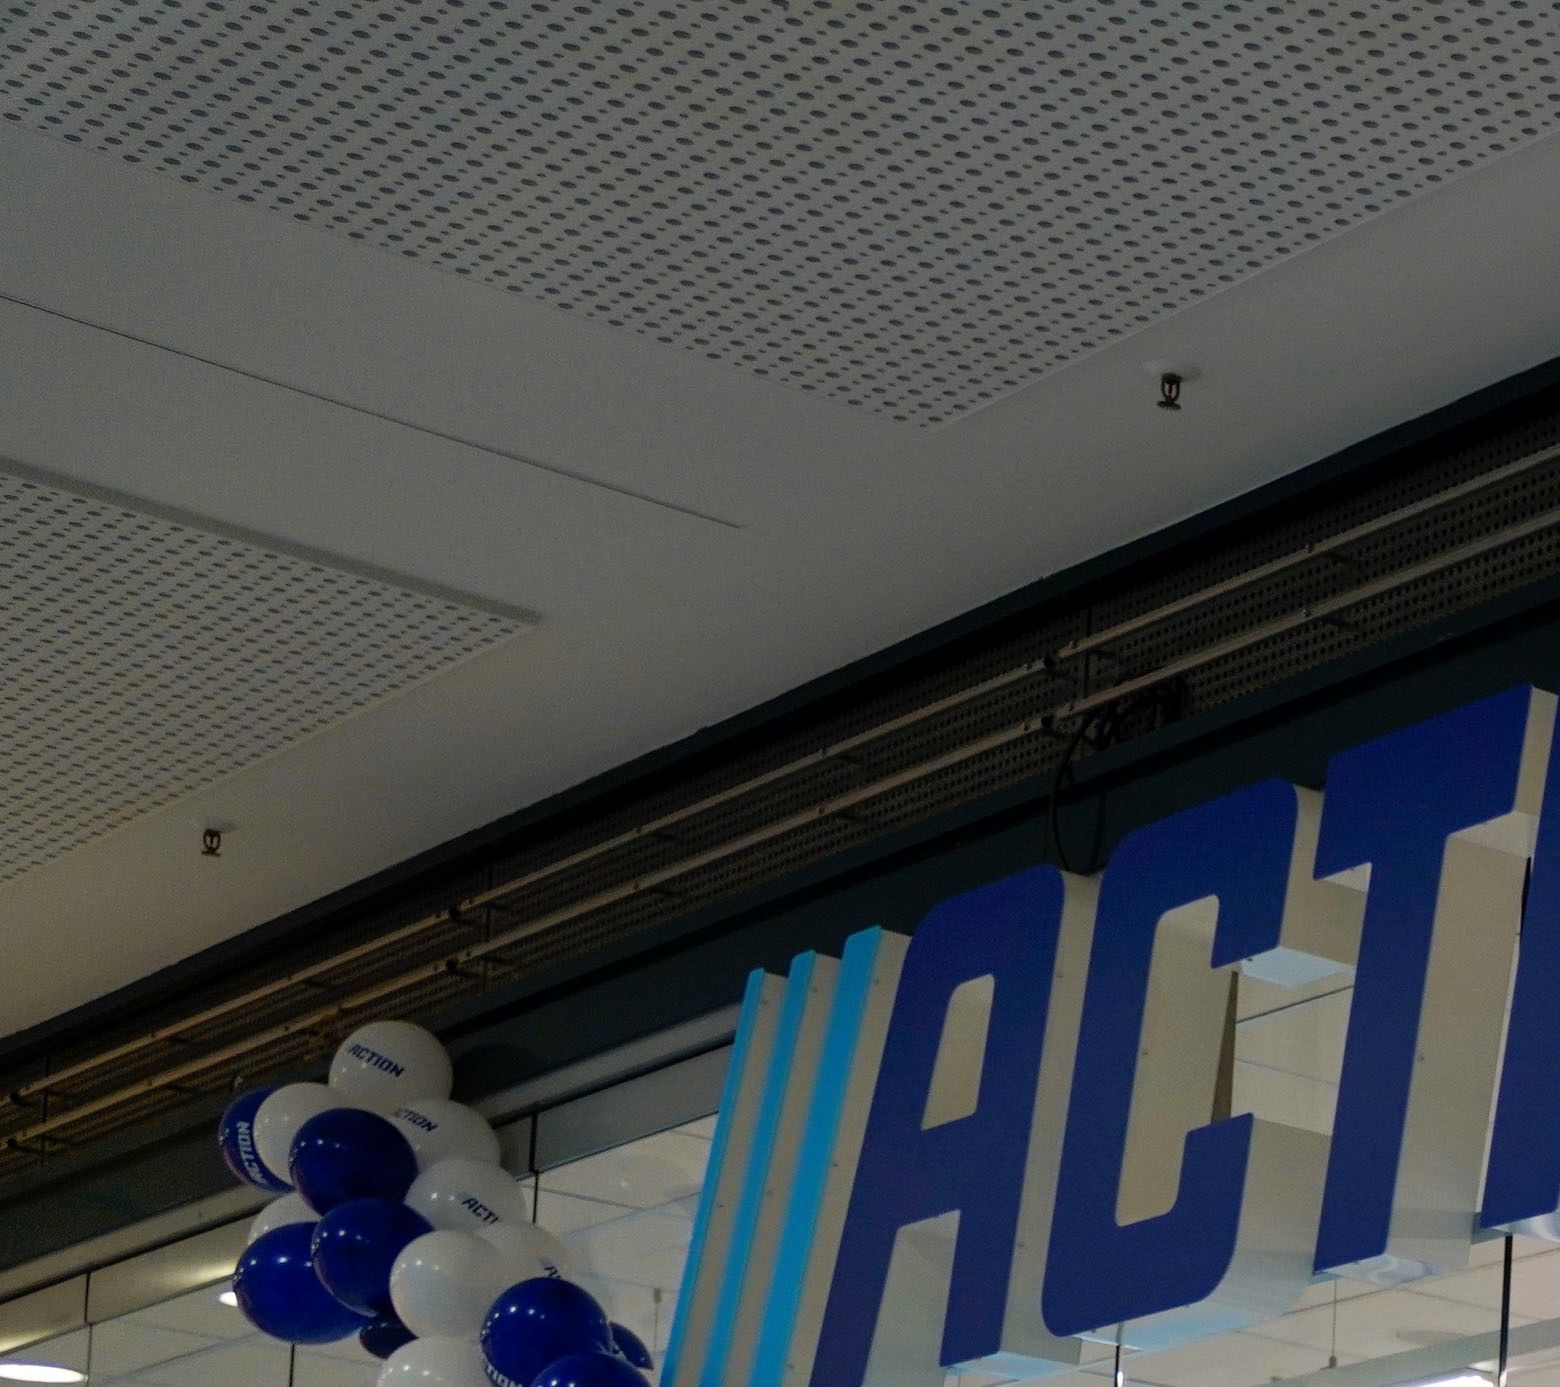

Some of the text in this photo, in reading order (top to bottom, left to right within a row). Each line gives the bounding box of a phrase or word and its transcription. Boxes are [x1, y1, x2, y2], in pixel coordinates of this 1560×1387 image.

[349, 1043, 405, 1078] ACTION
[394, 1108, 438, 1134] CTION
[460, 1197, 502, 1225] ACTI
